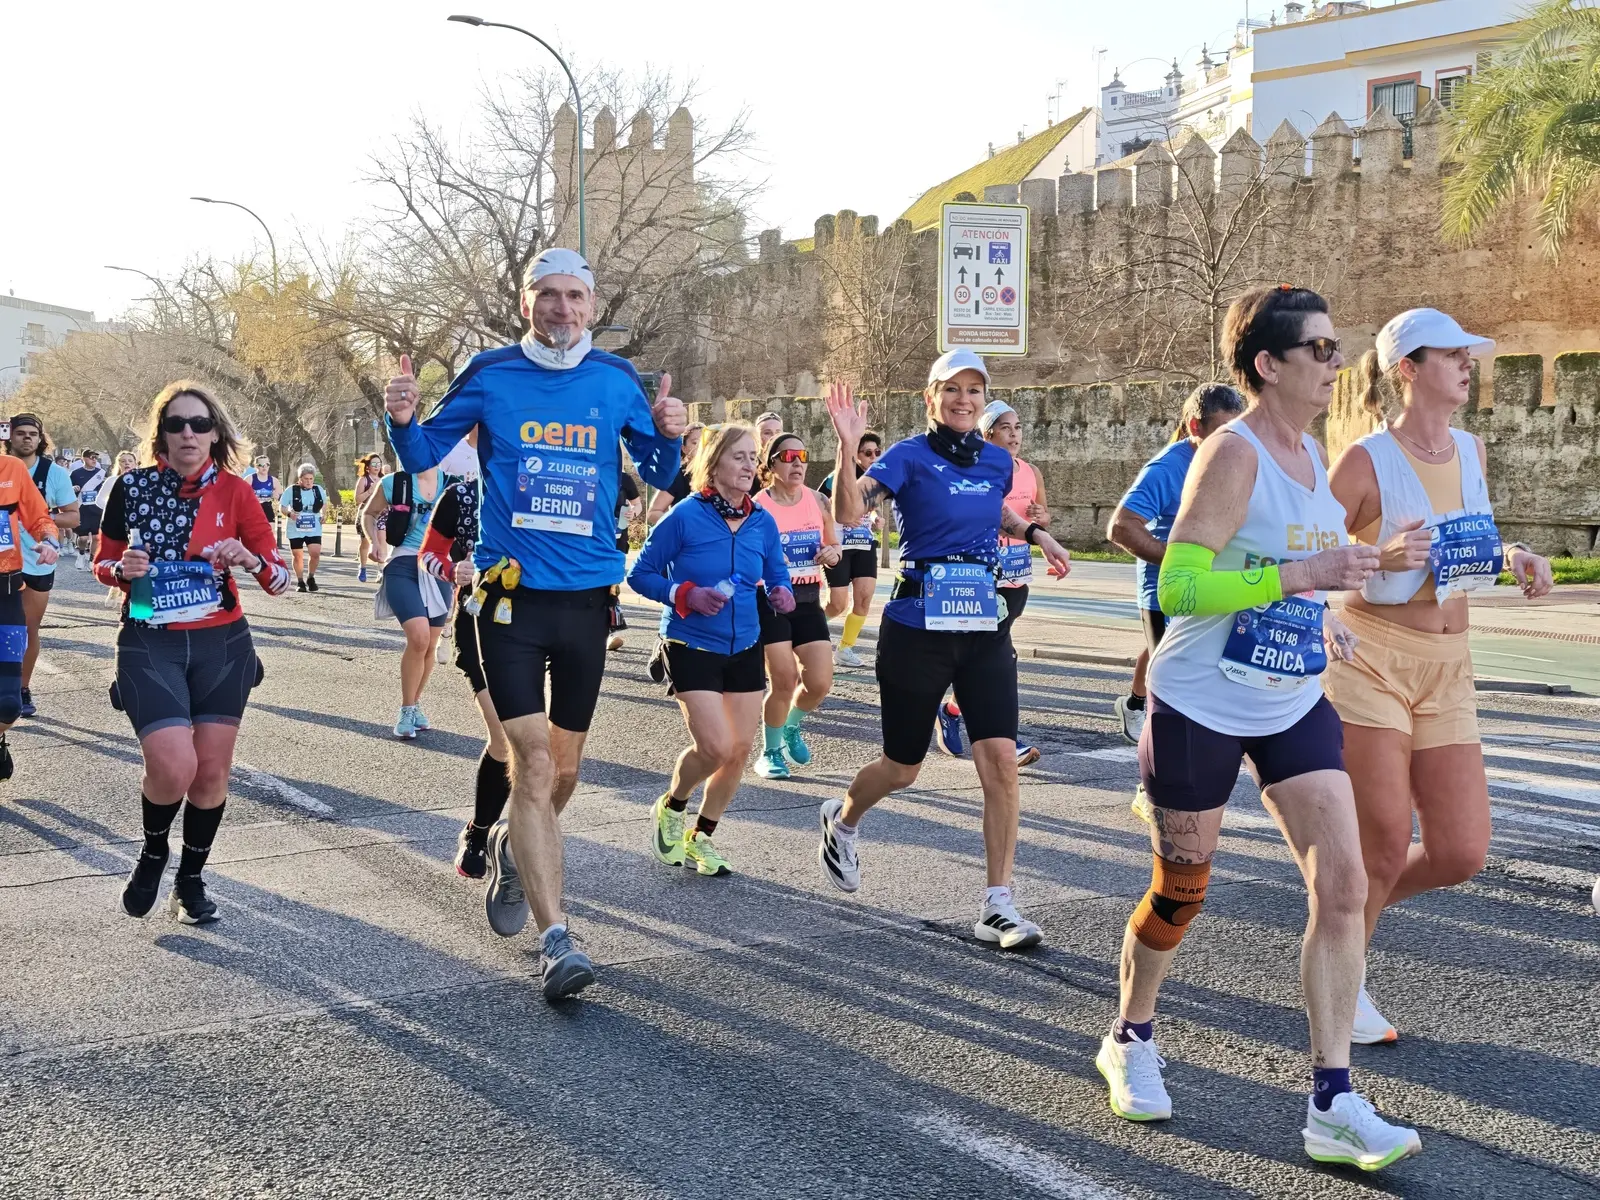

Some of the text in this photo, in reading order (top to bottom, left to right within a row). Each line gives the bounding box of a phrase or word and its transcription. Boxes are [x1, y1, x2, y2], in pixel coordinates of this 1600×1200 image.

[962, 229, 1010, 240] ATENCIÓN
[979, 330, 1009, 338] HISTÓRICA
[520, 421, 597, 449] oem
[547, 462, 591, 477] ZURICH
[544, 483, 574, 496] 16596
[530, 496, 582, 516] BERND
[216, 512, 224, 527] K
[1445, 520, 1491, 535] ZURICH
[792, 533, 817, 542] ZURICH
[1286, 523, 1340, 551] Erica
[1445, 545, 1477, 560] 17051
[163, 564, 204, 574] ZURICH
[951, 567, 987, 578] ZURICH
[164, 579, 190, 591] 17727
[949, 587, 975, 597] 17595
[942, 600, 983, 614] DIANA
[1275, 601, 1319, 621] ZURICH
[1268, 628, 1298, 647] 16148
[1250, 644, 1305, 673] ERICA
[1231, 667, 1247, 677] asics
